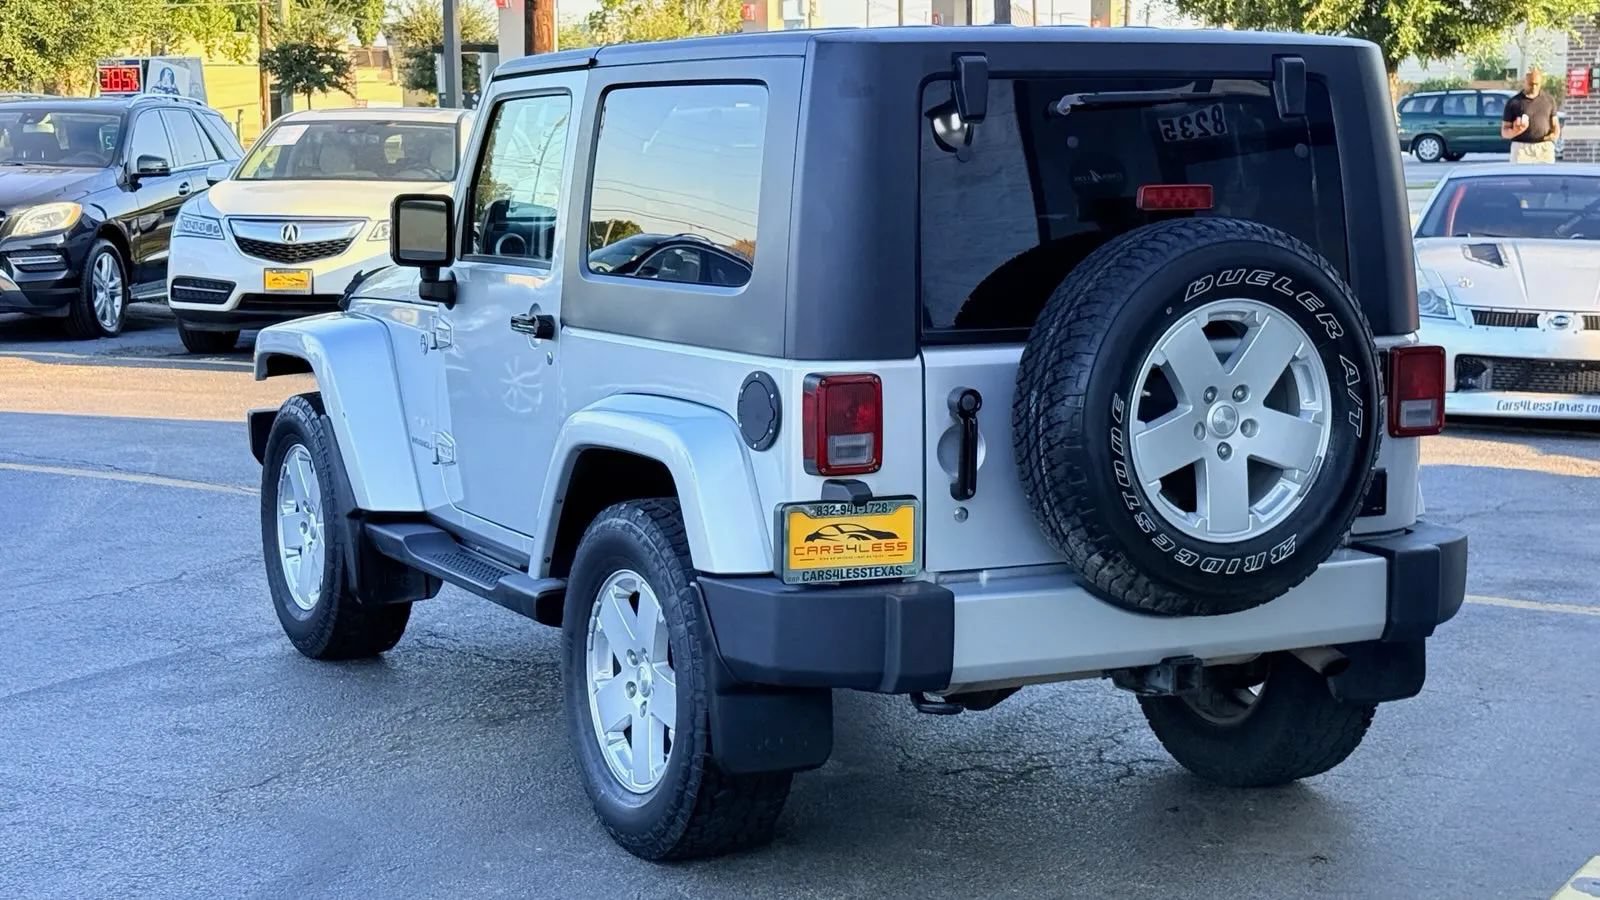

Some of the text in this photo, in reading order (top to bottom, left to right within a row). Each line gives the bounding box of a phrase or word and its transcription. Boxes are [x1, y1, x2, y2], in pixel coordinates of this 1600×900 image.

[1184, 268, 1364, 438] DUELER A/T
[1110, 392, 1298, 575] BRIDGESTONE
[793, 541, 908, 556] CARS4LESS
[801, 565, 903, 582] CARS4LESSTEXAS
